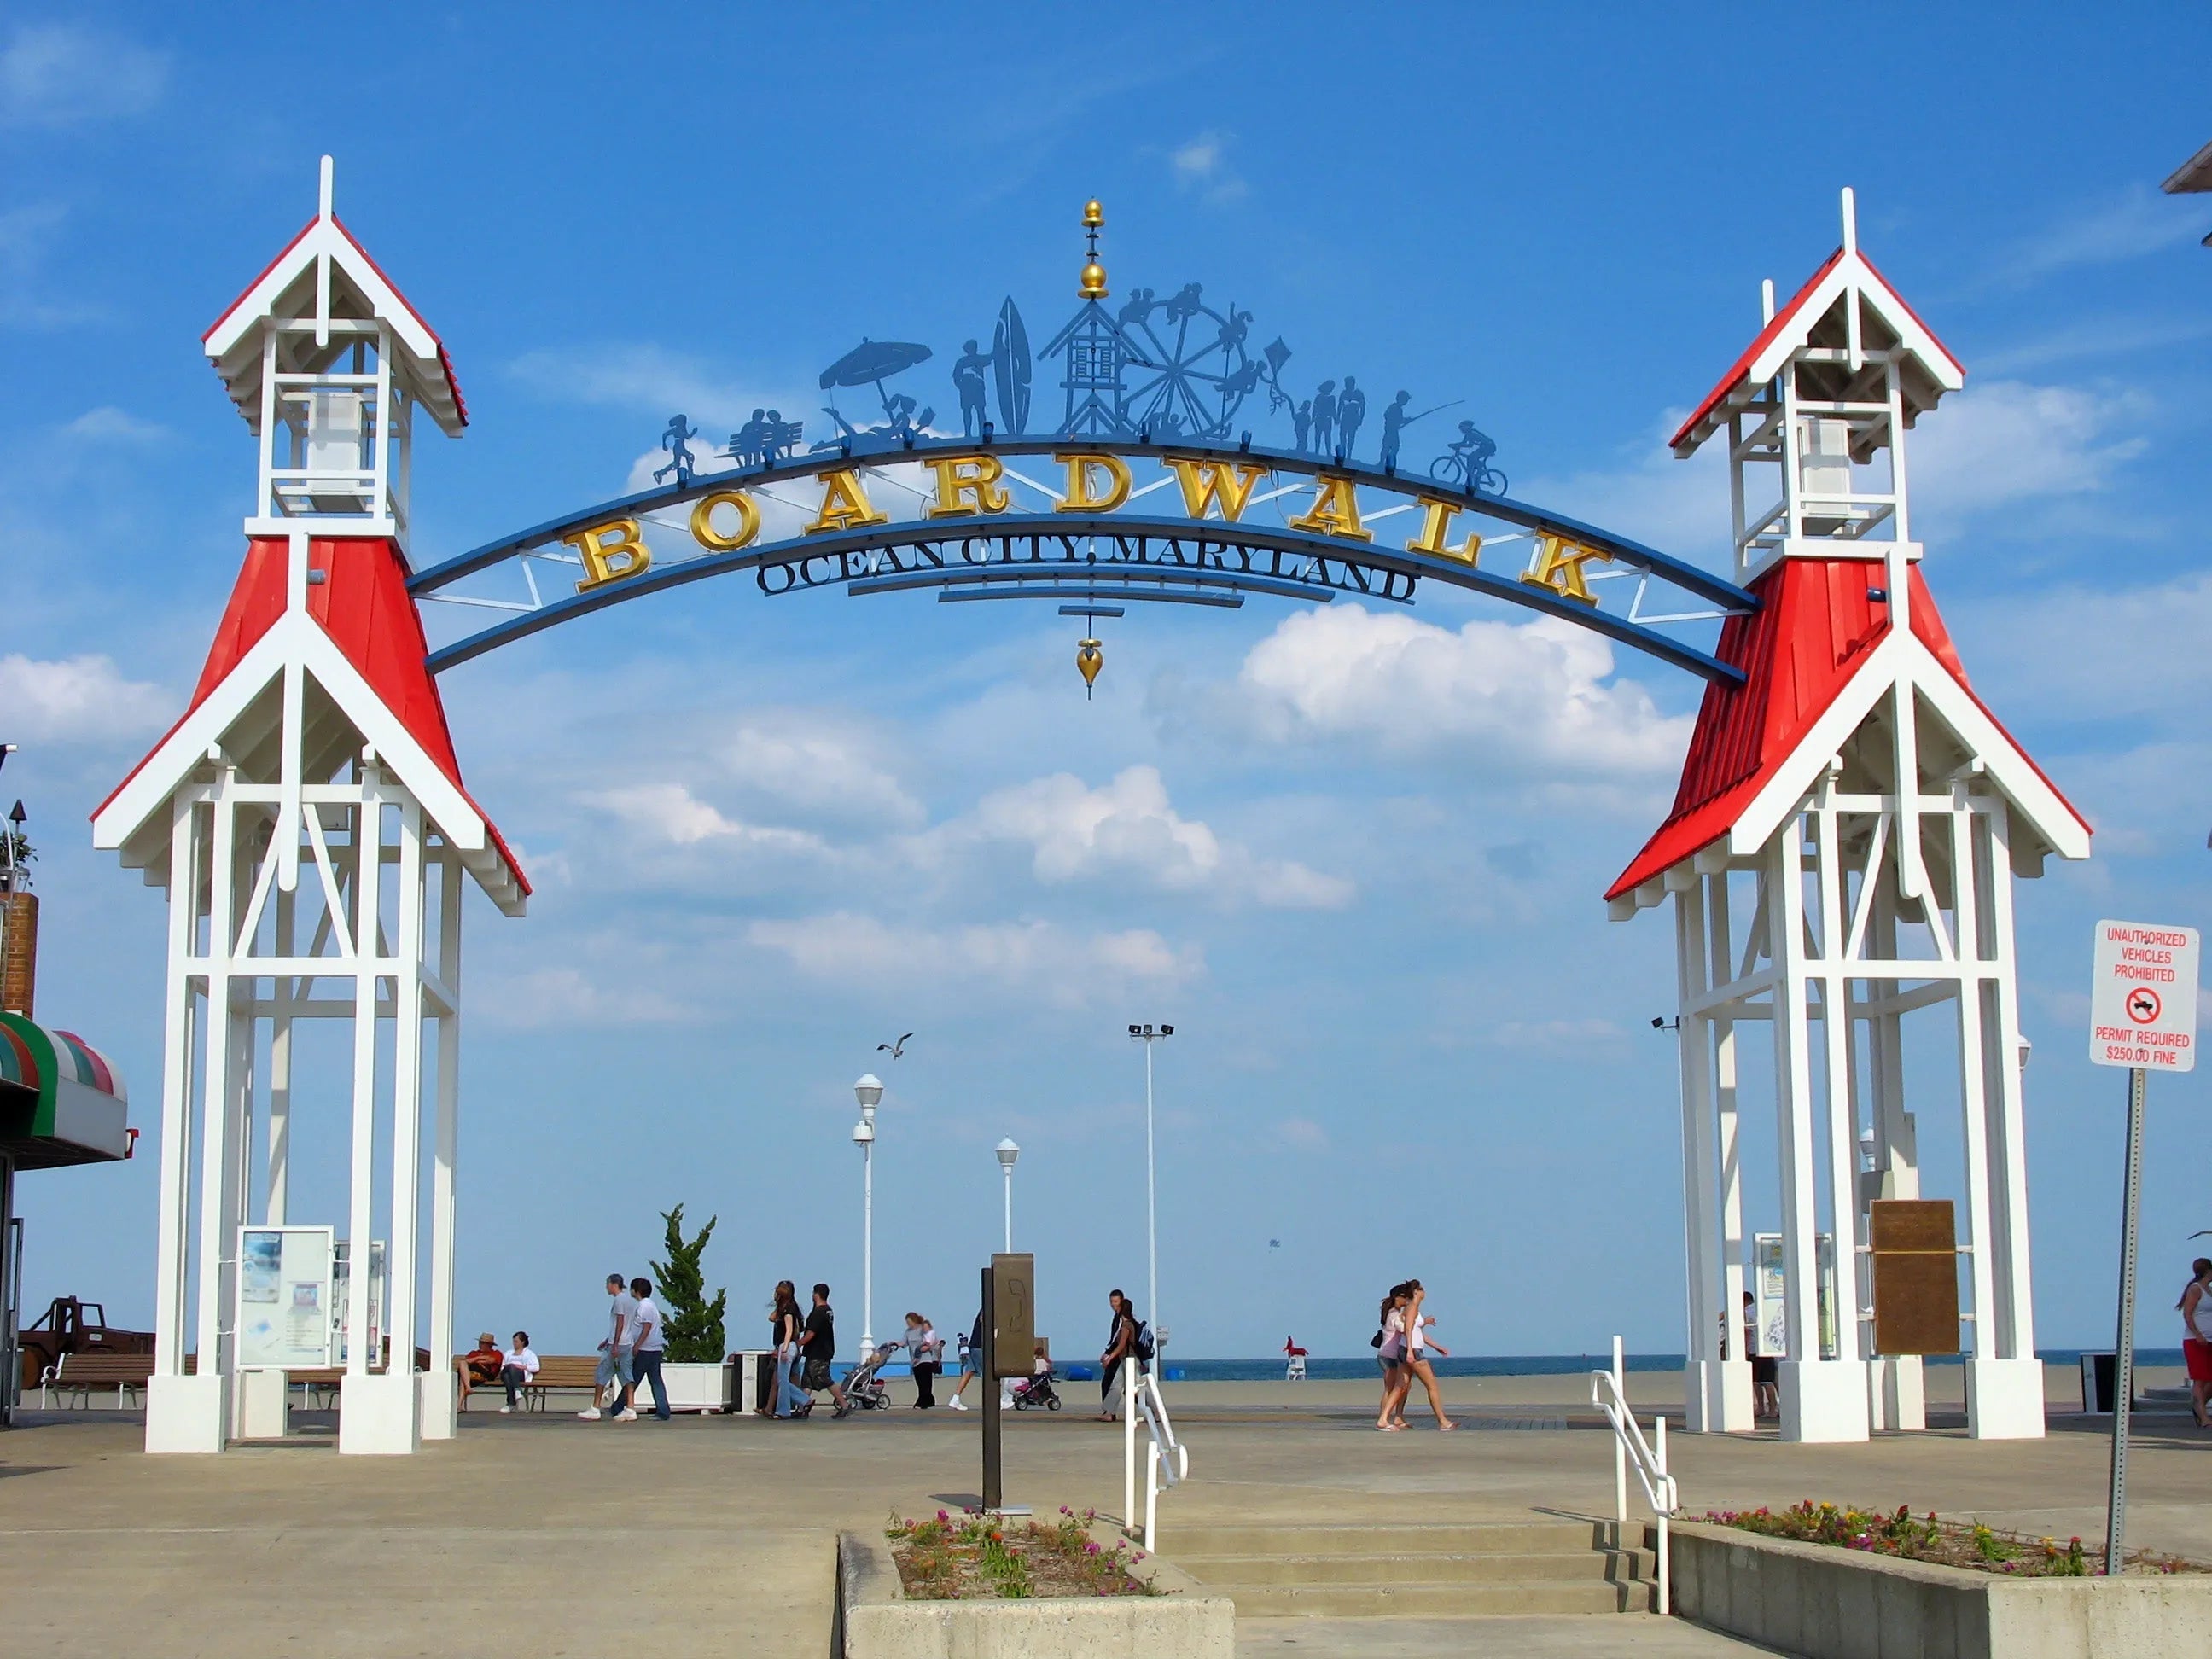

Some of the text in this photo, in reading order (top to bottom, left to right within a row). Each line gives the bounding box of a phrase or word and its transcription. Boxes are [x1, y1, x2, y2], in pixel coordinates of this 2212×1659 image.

[562, 452, 1614, 608] BOARDWALK
[757, 534, 1417, 600] OCEAN CITY, MARYLAND
[2107, 928, 2186, 947] UNAUTHORIZED
[2122, 947, 2171, 963] VEHICLES
[2114, 964, 2174, 982] PROHIBITED
[2096, 1027, 2190, 1047] PERMIT REQUIRED
[2106, 1045, 2176, 1064] $250.00 FINE
